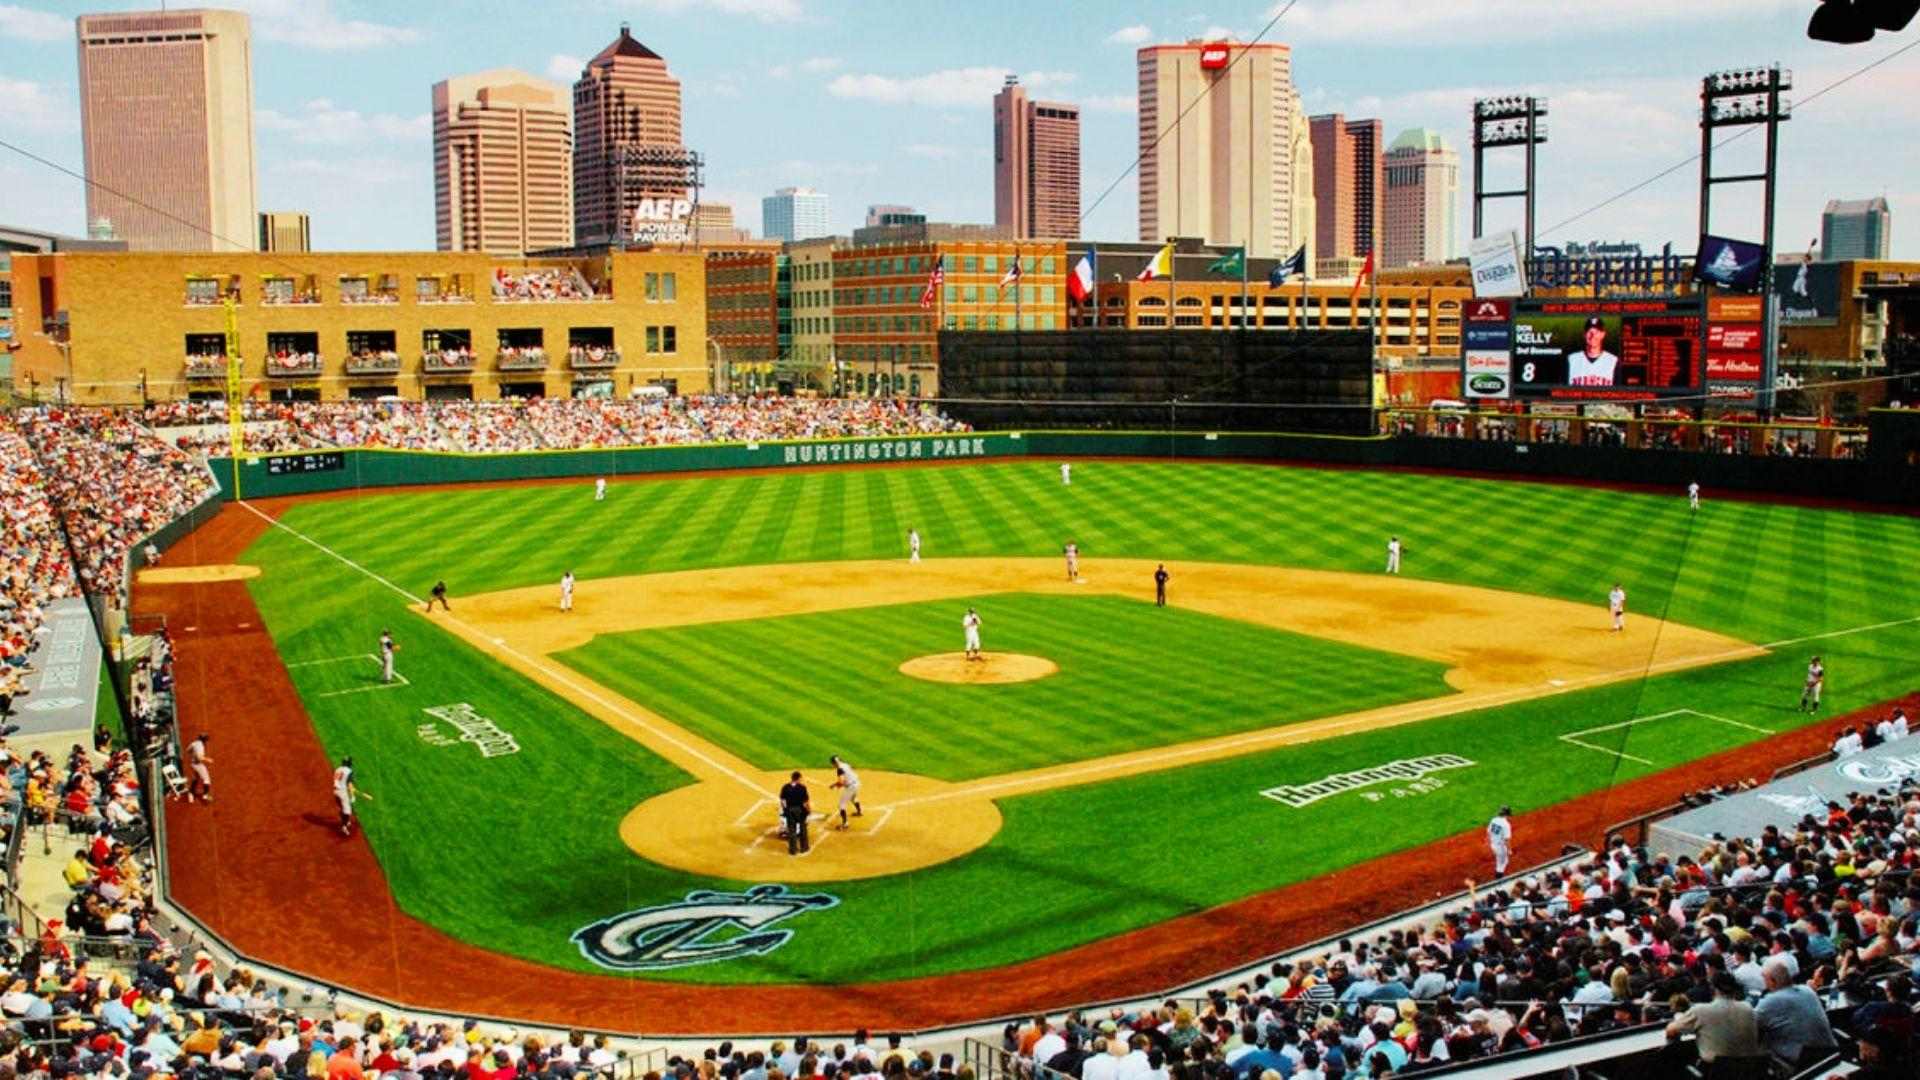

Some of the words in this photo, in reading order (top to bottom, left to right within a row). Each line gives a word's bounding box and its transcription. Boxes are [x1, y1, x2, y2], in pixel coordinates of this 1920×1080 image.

[635, 198, 692, 220] AEP
[639, 222, 688, 232] POWER
[633, 233, 691, 242] PAVILION
[1566, 241, 1586, 255] The
[1588, 240, 1641, 256] Columbus
[1516, 333, 1552, 343] KELLY
[1522, 362, 1536, 382] 8
[784, 441, 922, 463] HUNTINGTON
[933, 439, 985, 456] PARK
[1261, 754, 1475, 807] Huntington
